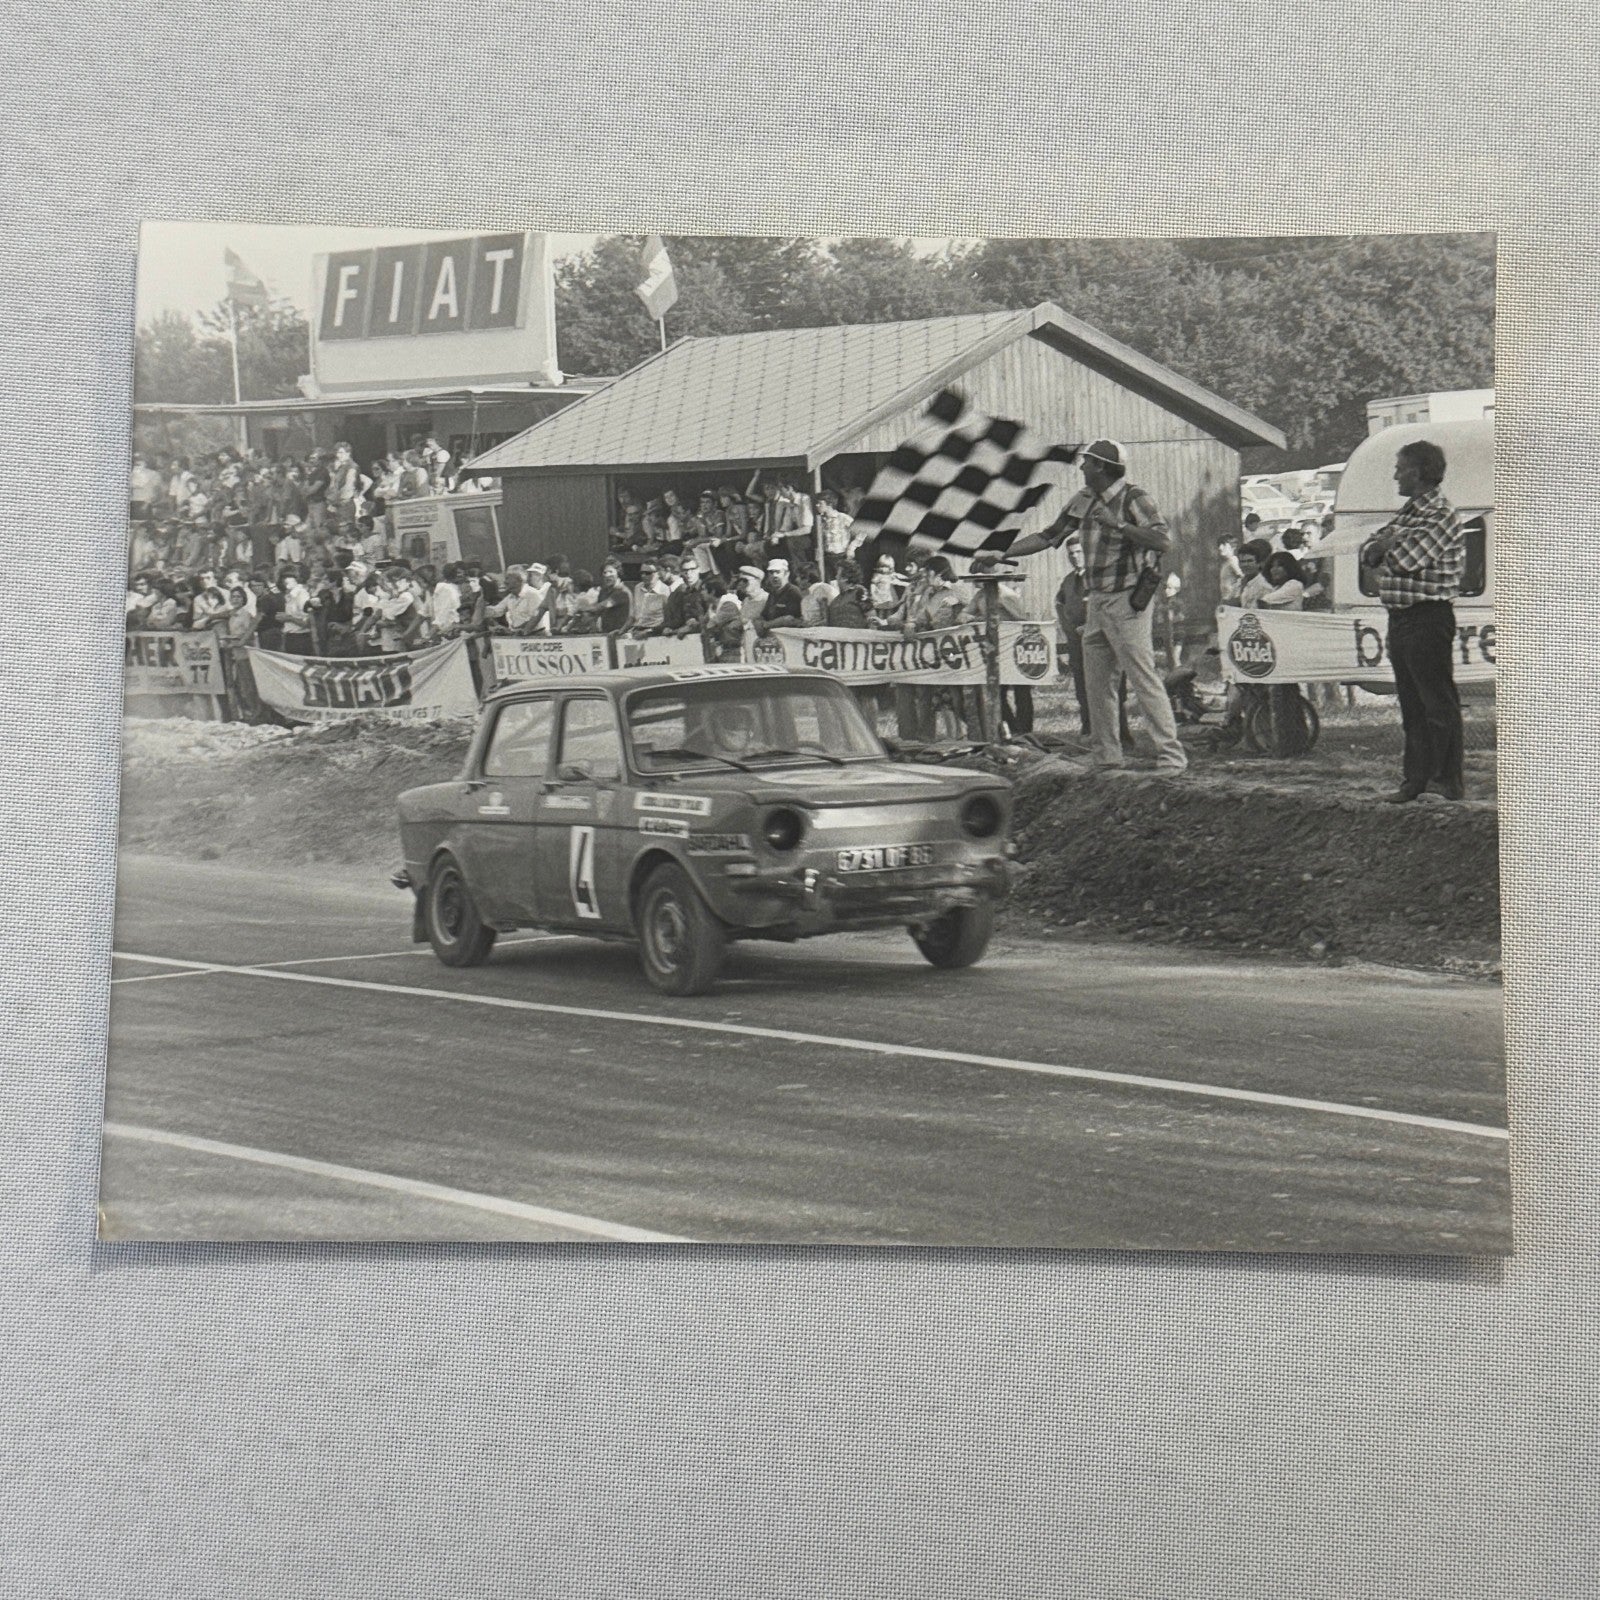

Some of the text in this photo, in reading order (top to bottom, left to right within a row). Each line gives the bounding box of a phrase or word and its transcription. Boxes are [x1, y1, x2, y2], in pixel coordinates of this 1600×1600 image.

[334, 249, 514, 326] FIAT
[1016, 644, 1048, 664] Bridel
[1232, 640, 1273, 662] Bridel
[505, 654, 588, 675] ECUSSON
[303, 663, 411, 701] FIAT
